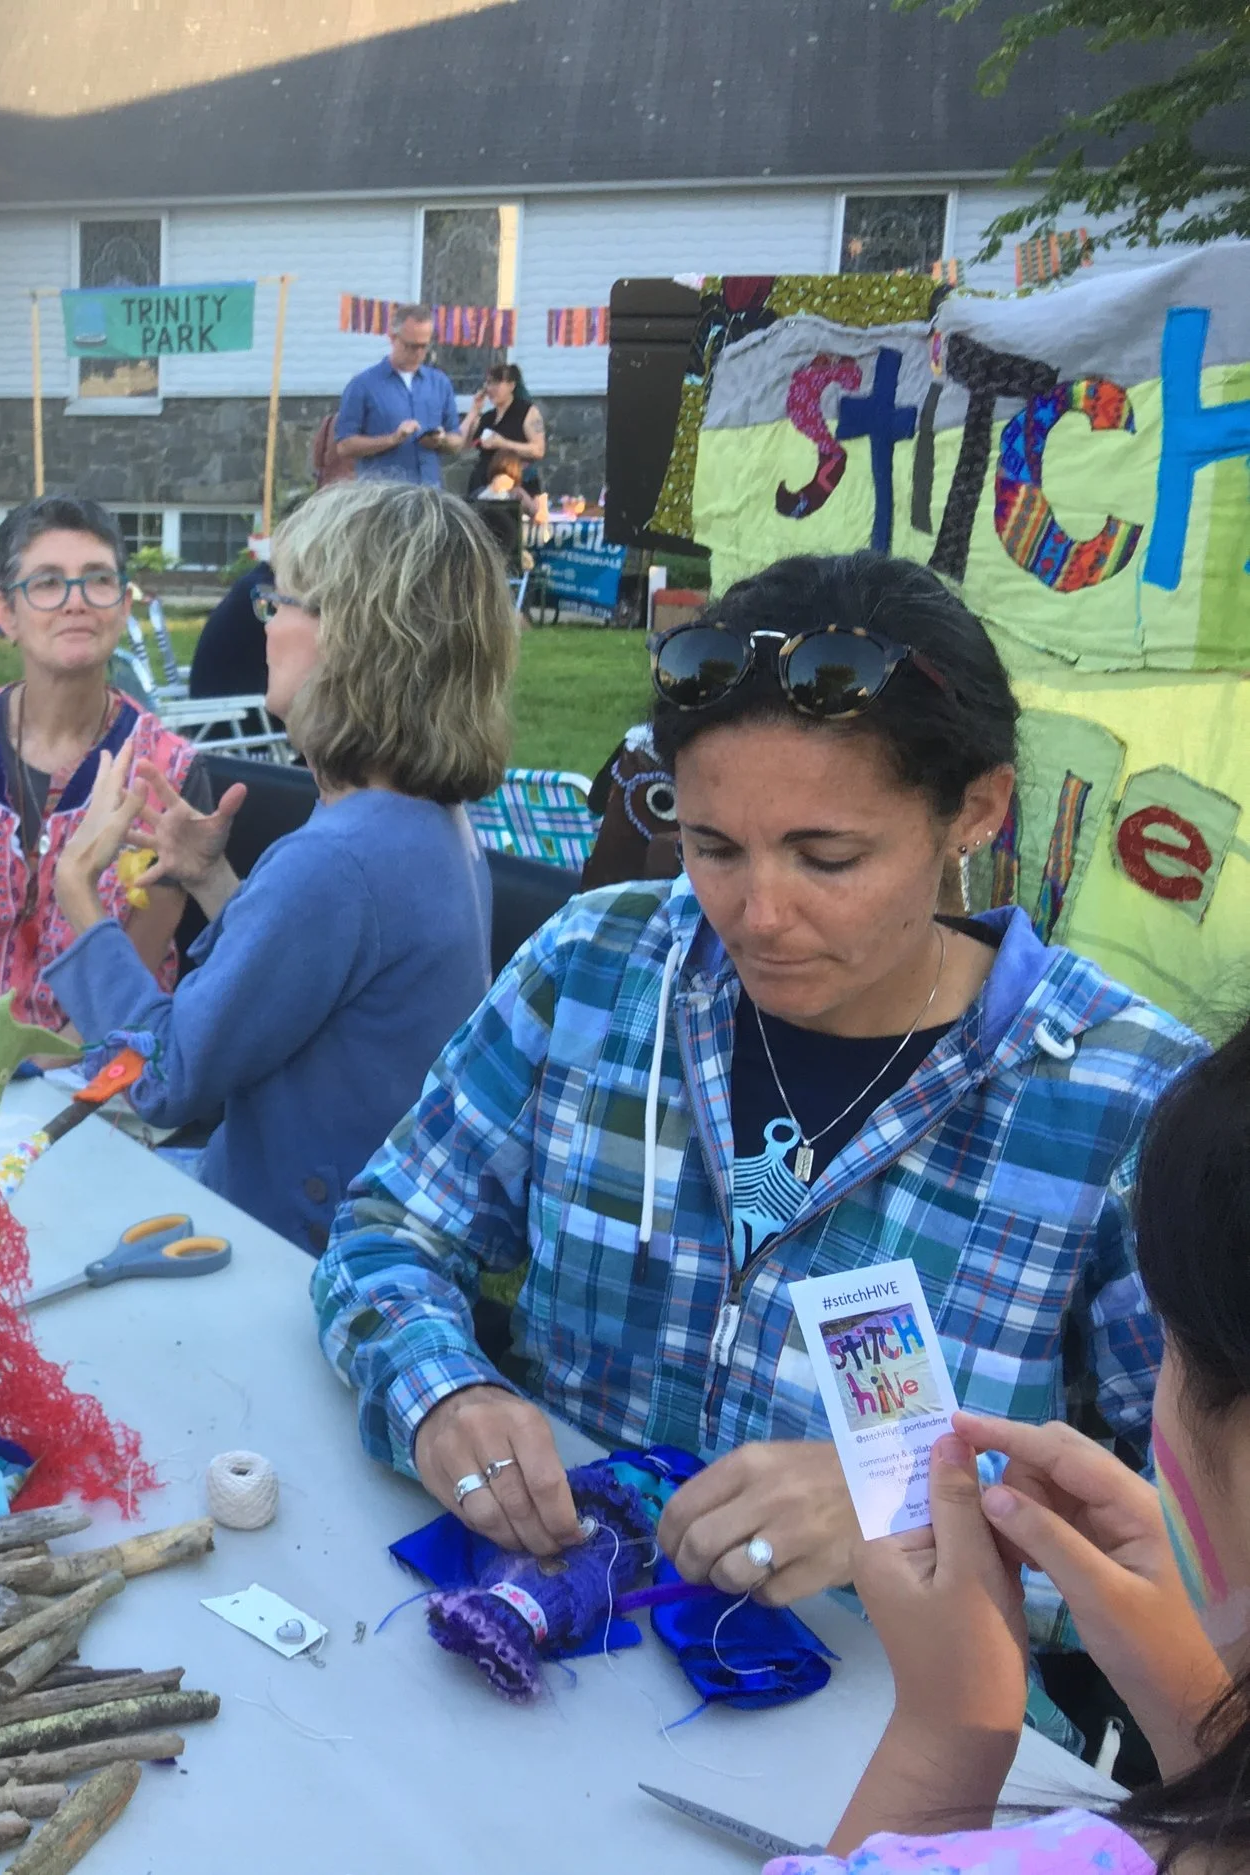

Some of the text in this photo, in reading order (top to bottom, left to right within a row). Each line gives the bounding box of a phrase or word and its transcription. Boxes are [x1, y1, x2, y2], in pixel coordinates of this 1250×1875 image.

[120, 294, 228, 326] TRINITY
[141, 322, 219, 354] PARK
[521, 518, 623, 555] UPPLIE
[822, 1281, 900, 1310] #stitchHIVE
[859, 1453, 900, 1468] community
[909, 1444, 932, 1455] collab
[869, 1465, 898, 1479] through
